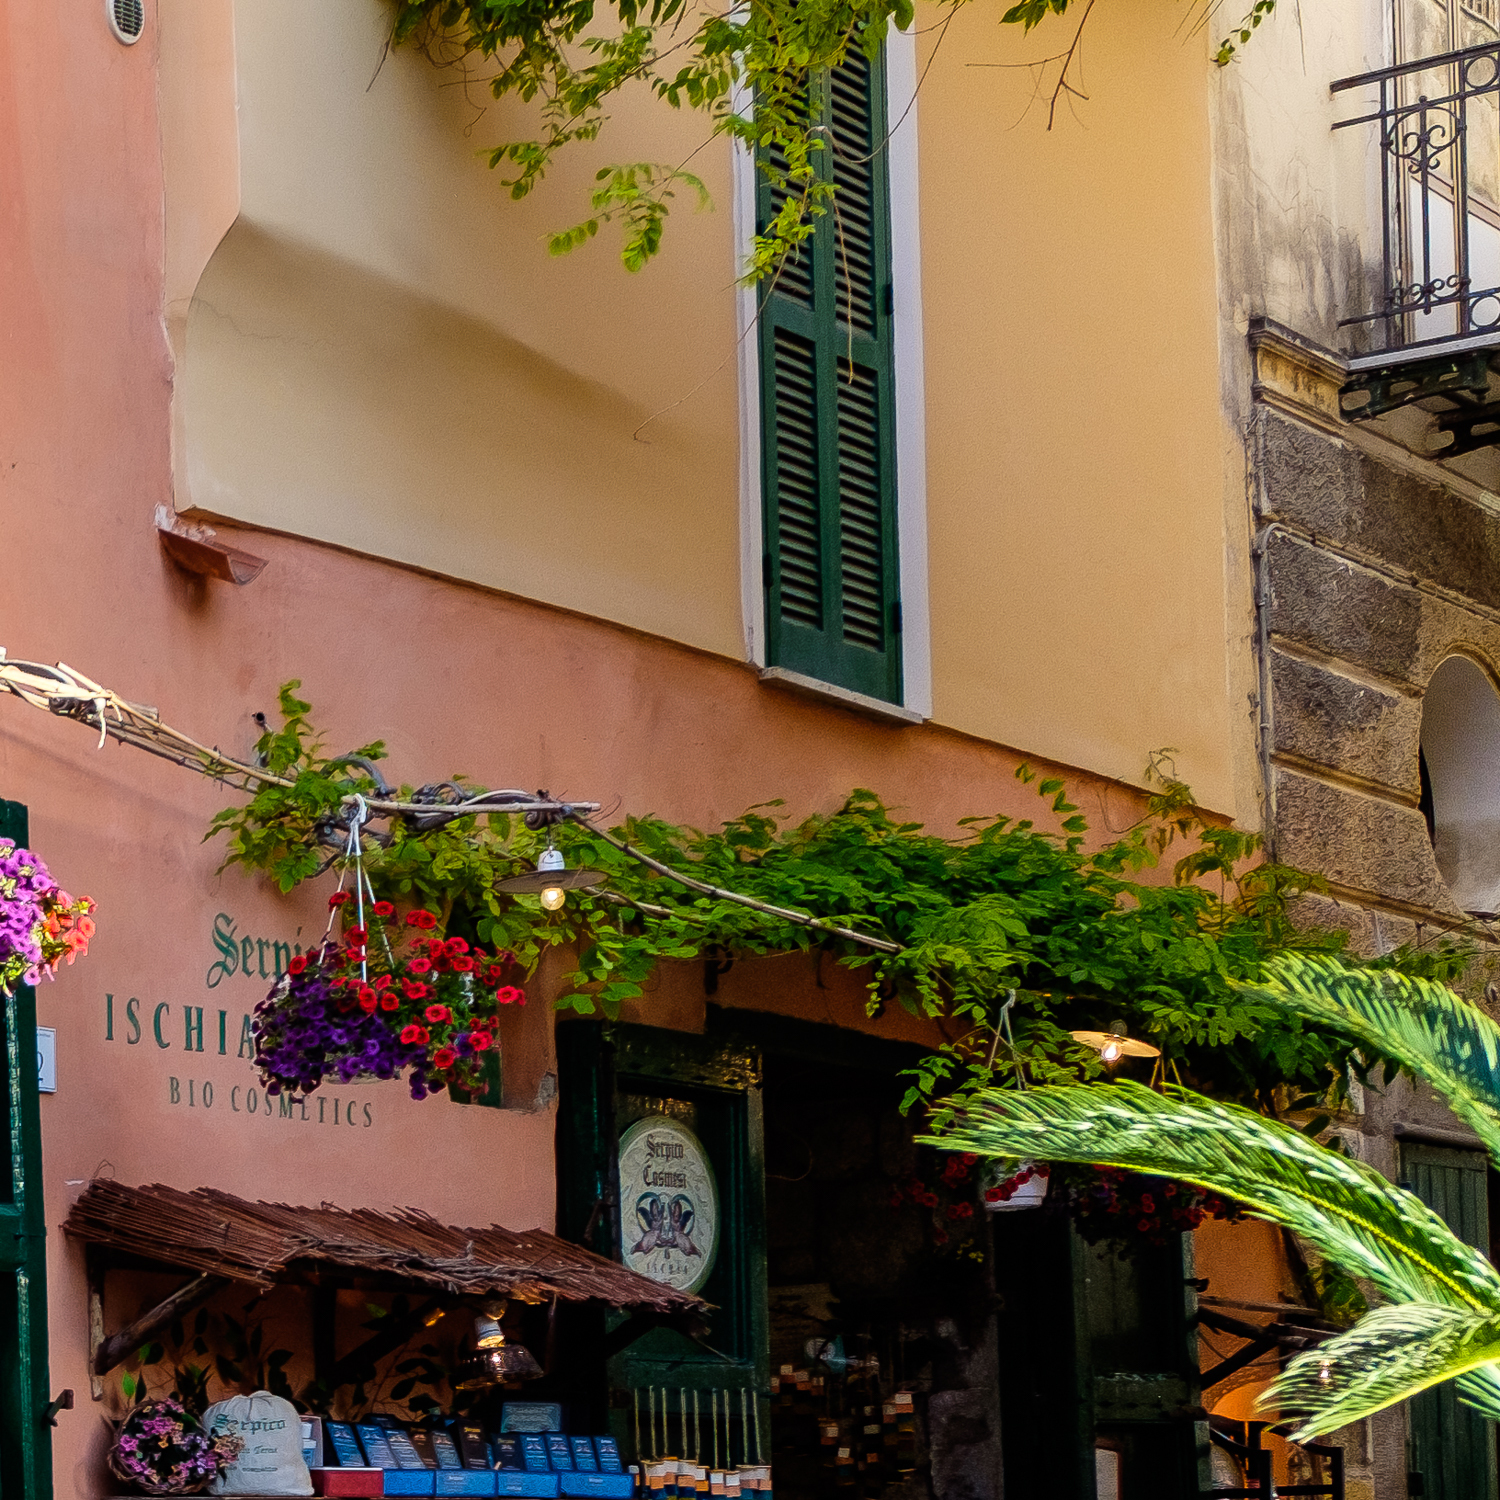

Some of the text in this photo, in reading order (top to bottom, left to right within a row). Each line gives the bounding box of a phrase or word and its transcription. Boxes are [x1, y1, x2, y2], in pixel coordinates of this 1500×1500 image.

[104, 993, 256, 1060] ISCHIA
[169, 1076, 373, 1128] BIO COSMETICS
